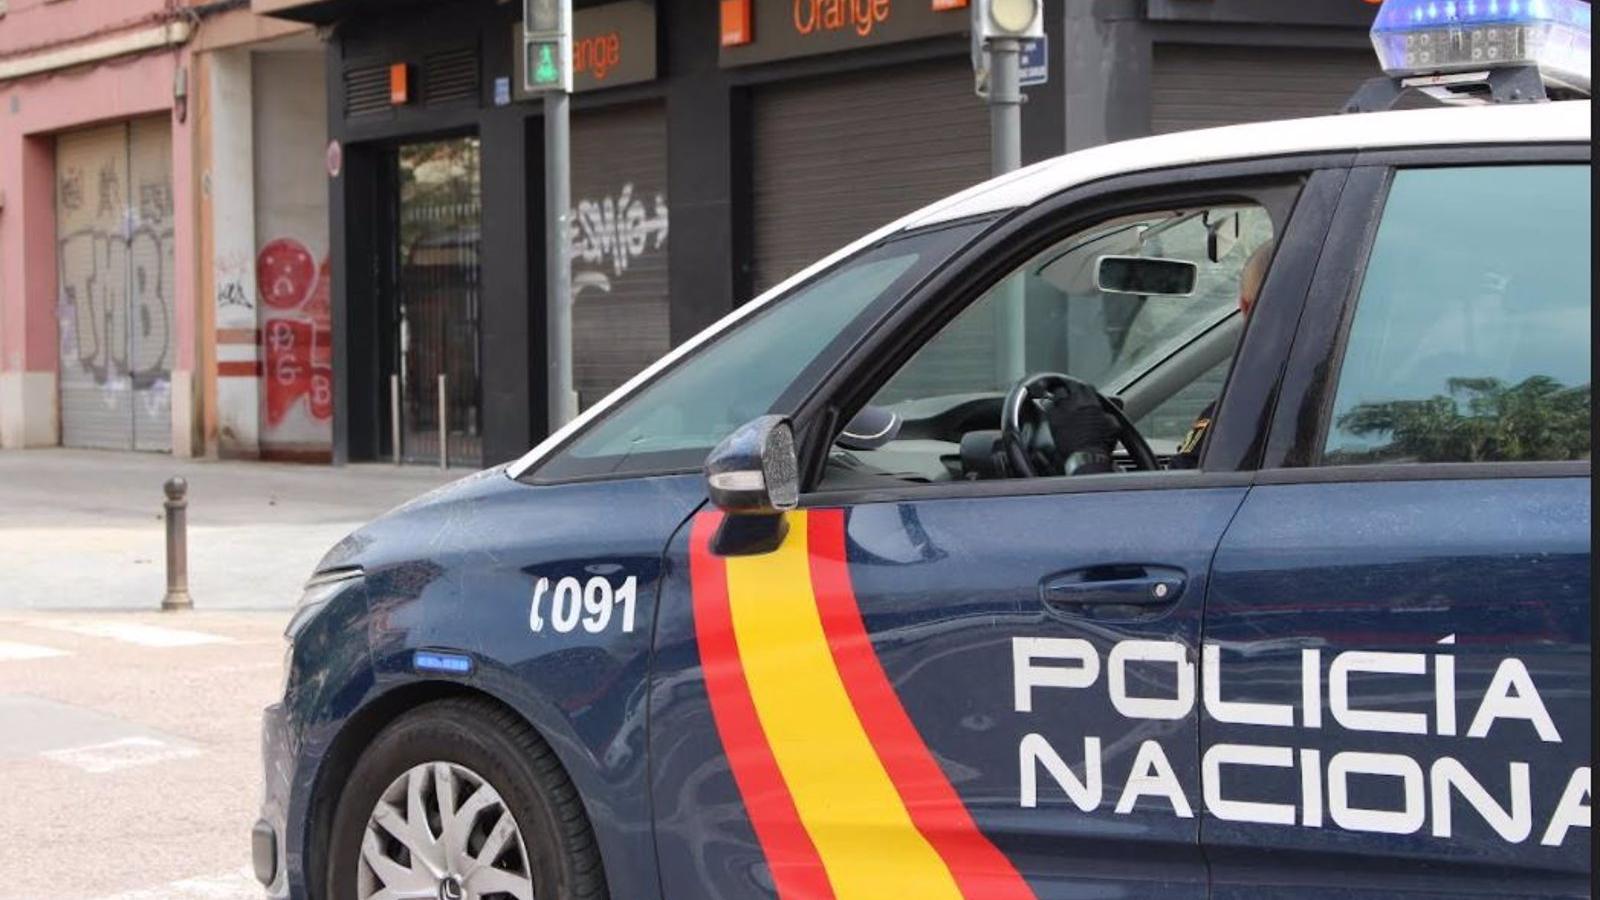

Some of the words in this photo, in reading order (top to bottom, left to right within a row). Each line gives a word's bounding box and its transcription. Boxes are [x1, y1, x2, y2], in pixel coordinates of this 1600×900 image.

[793, 0, 890, 36] Orange
[573, 31, 620, 80] ange
[551, 575, 637, 633] 091
[1012, 633, 1562, 742] POLICÍA
[1018, 732, 1591, 847] NACIONA
